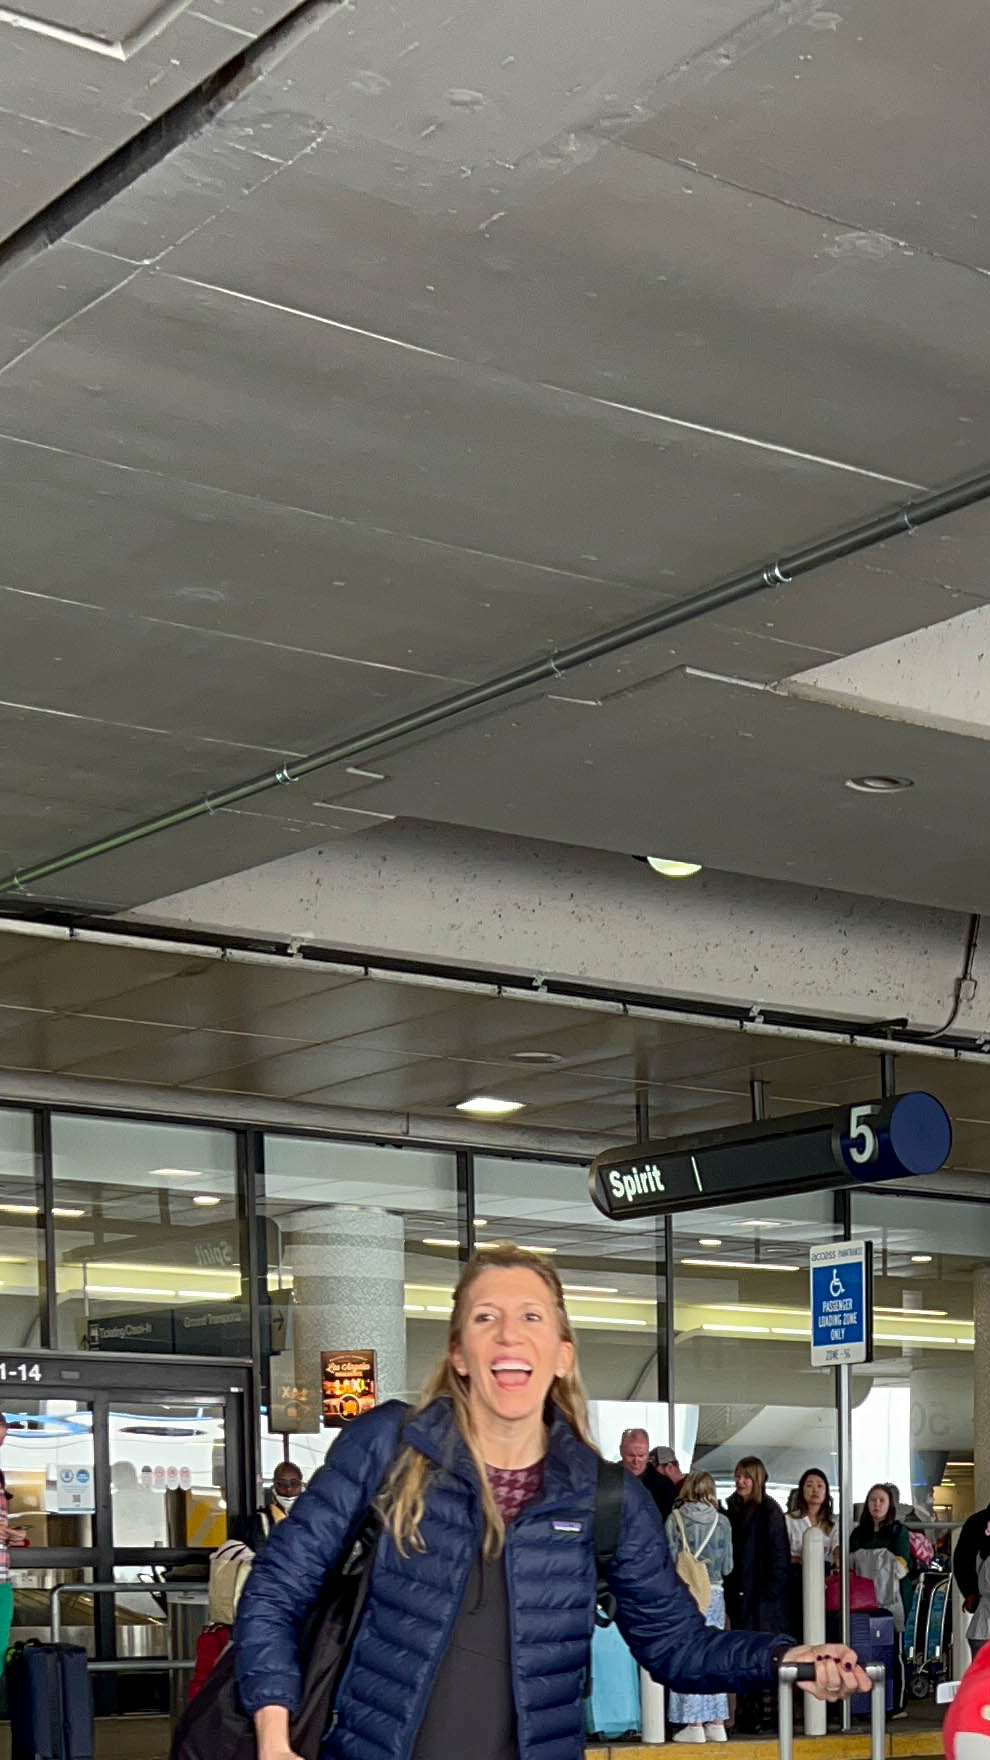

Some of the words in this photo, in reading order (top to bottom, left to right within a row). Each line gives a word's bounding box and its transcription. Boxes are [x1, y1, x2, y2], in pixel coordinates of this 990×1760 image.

[849, 1104, 882, 1164] 5
[608, 1164, 666, 1202] Spirit
[822, 1298, 853, 1313] PASSENGER
[818, 1314, 842, 1328] LOADING
[843, 1312, 858, 1325] ZONE
[830, 1328, 846, 1341] ONLY
